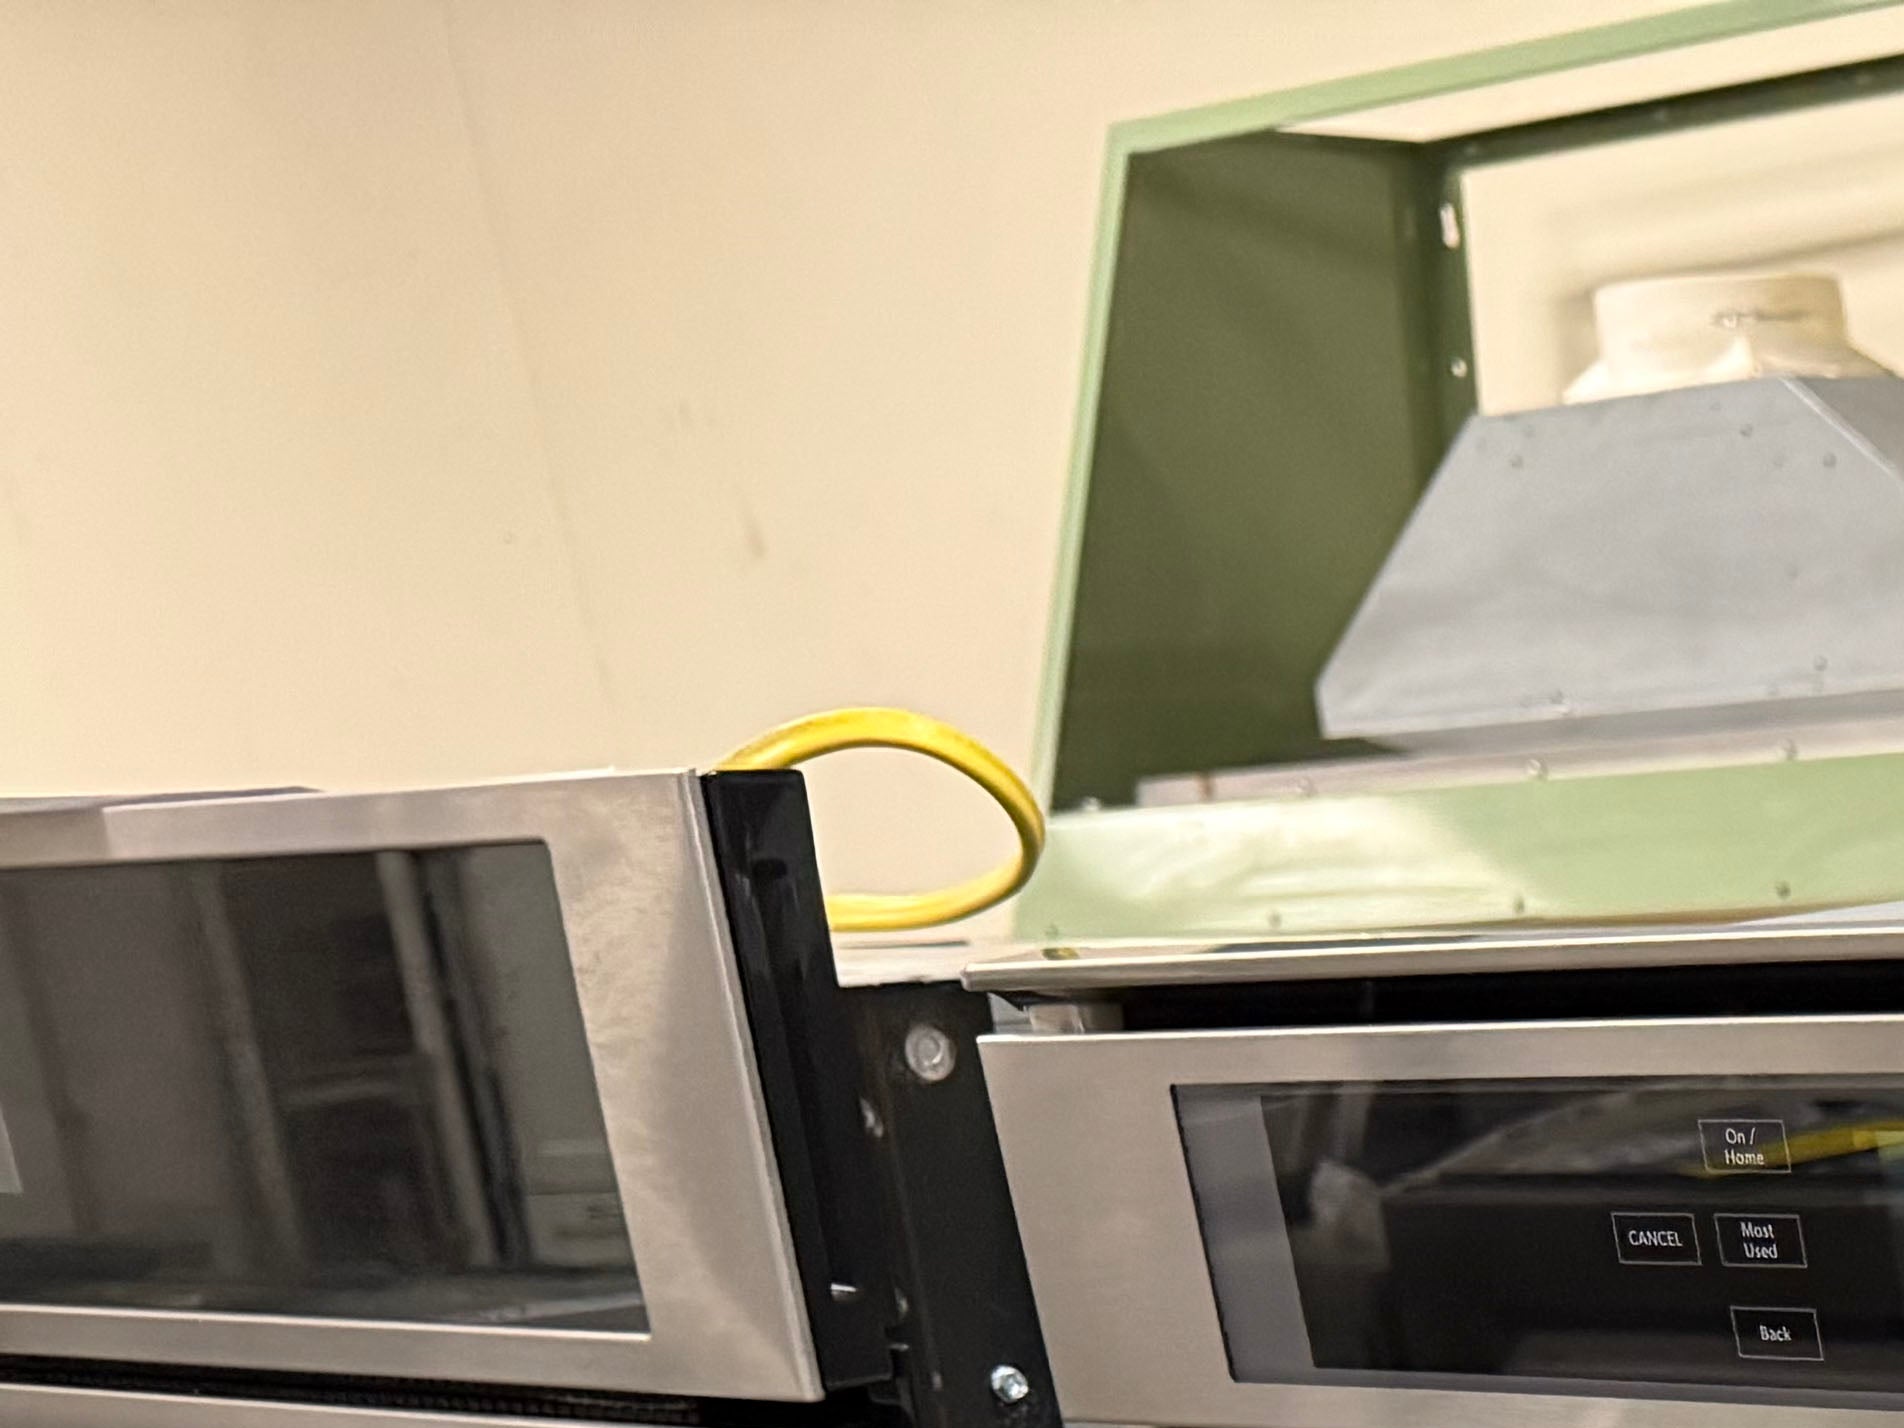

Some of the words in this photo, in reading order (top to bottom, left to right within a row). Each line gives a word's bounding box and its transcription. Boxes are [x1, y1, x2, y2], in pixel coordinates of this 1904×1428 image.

[1725, 1128, 1746, 1144] On
[1724, 1150, 1765, 1165] Home
[1740, 1221, 1775, 1239] Most
[1628, 1230, 1683, 1247] CANCEL
[1743, 1243, 1778, 1259] Used
[1760, 1325, 1792, 1342] Back
